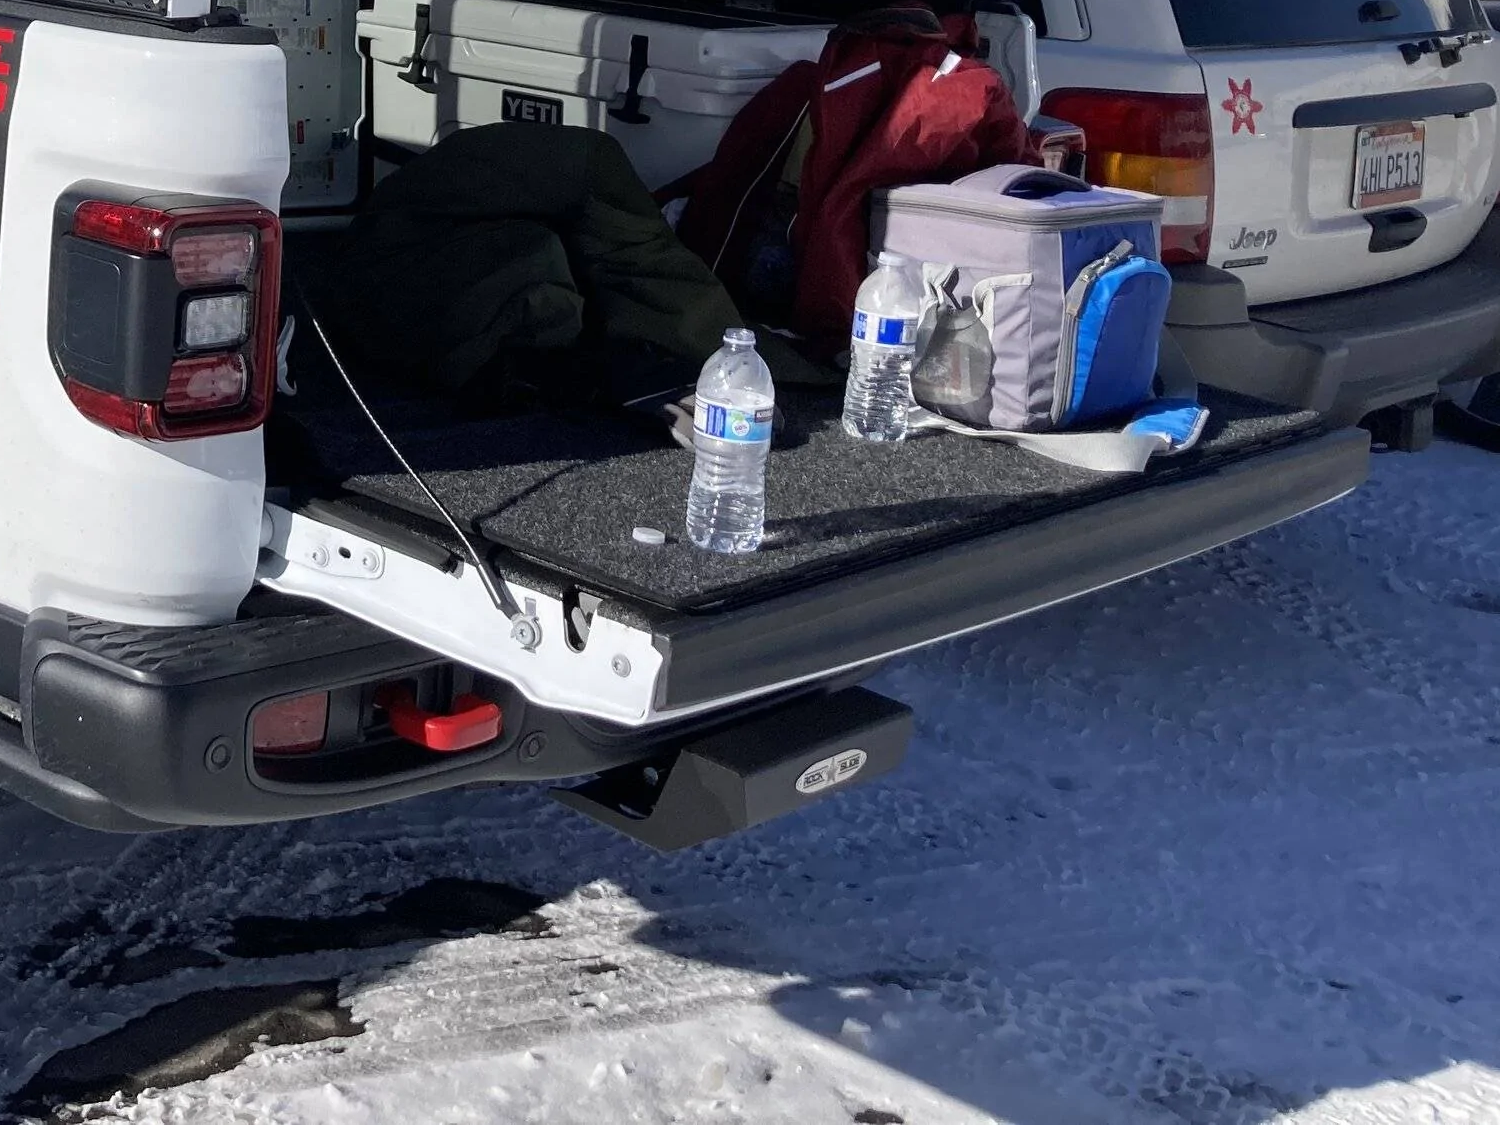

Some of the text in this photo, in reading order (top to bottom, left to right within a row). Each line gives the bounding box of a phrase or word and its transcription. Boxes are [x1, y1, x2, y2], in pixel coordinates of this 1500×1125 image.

[505, 96, 558, 125] YETI
[1360, 151, 1422, 194] 4HLP513
[1228, 226, 1278, 251] Jeep
